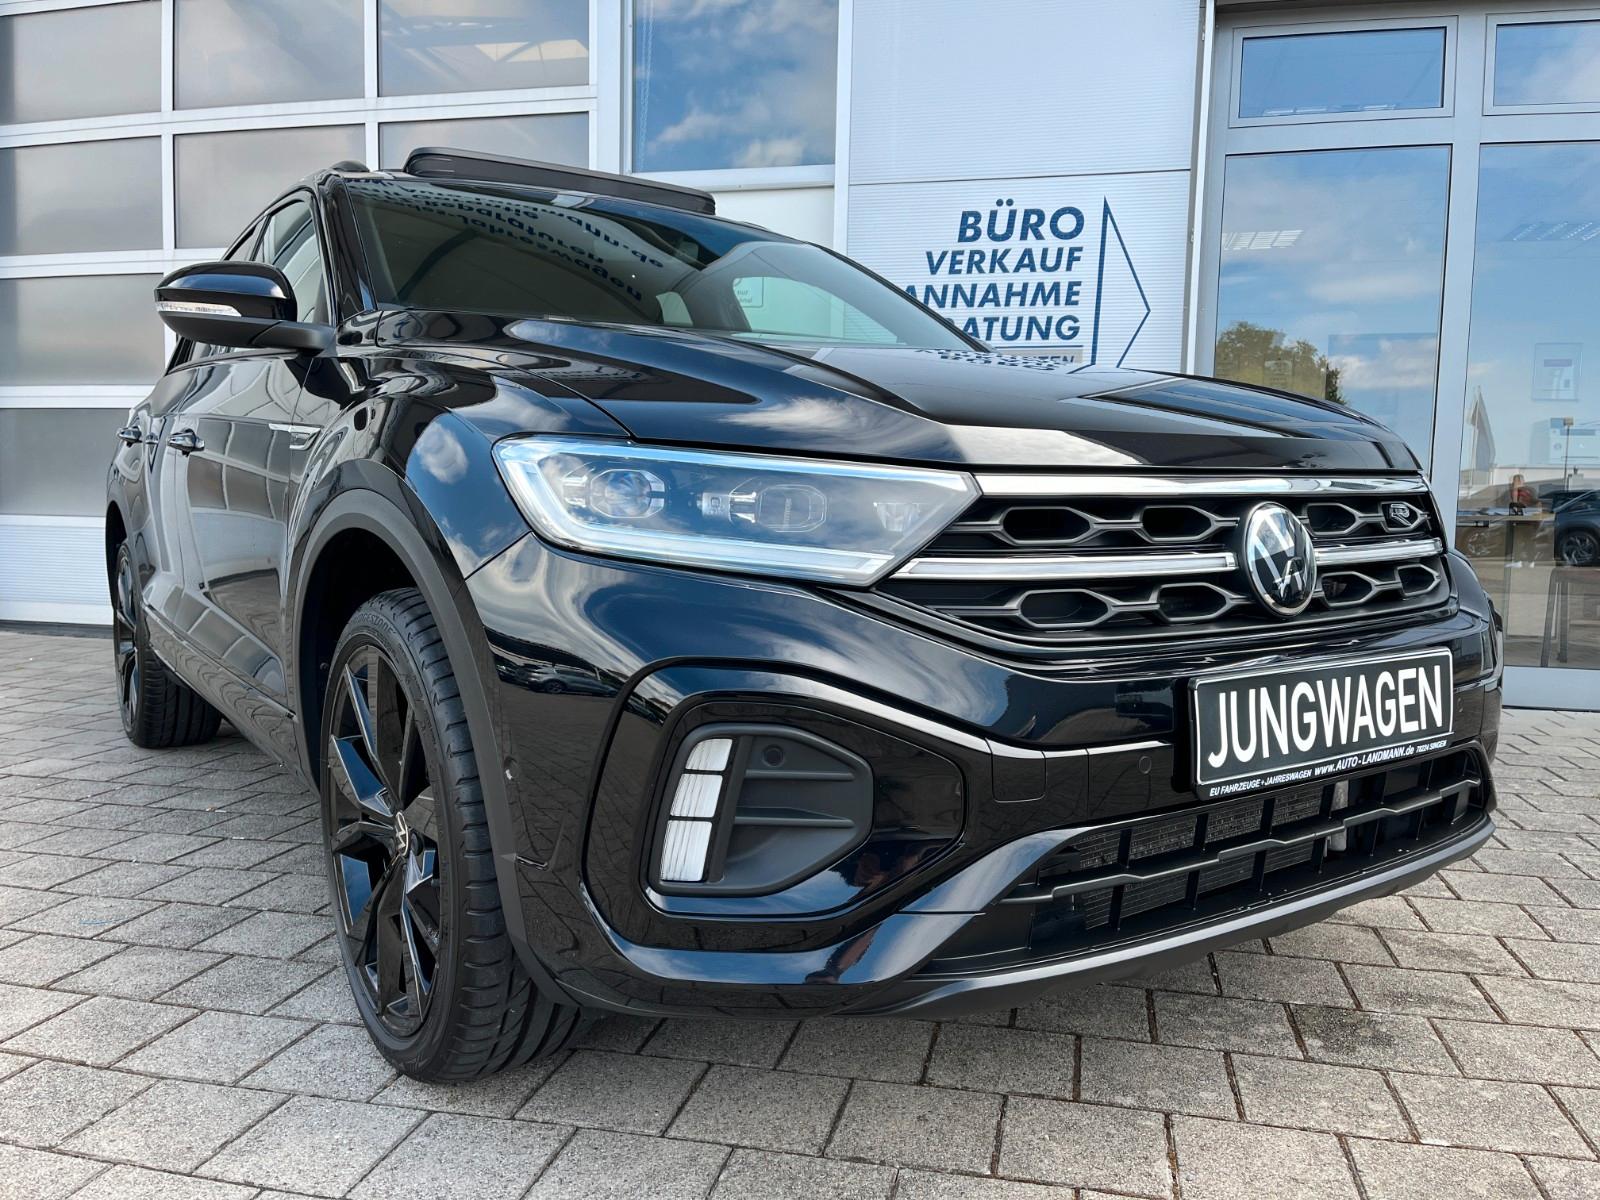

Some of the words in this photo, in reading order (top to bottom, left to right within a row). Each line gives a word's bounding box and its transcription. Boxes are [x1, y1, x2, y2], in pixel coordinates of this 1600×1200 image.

[957, 198, 1085, 243] BÜRO
[926, 246, 1084, 275] VERKAUF
[945, 314, 1081, 341] ATUNG
[1208, 665, 1441, 768] JUNGWAGEN
[1209, 786, 1220, 797] EU
